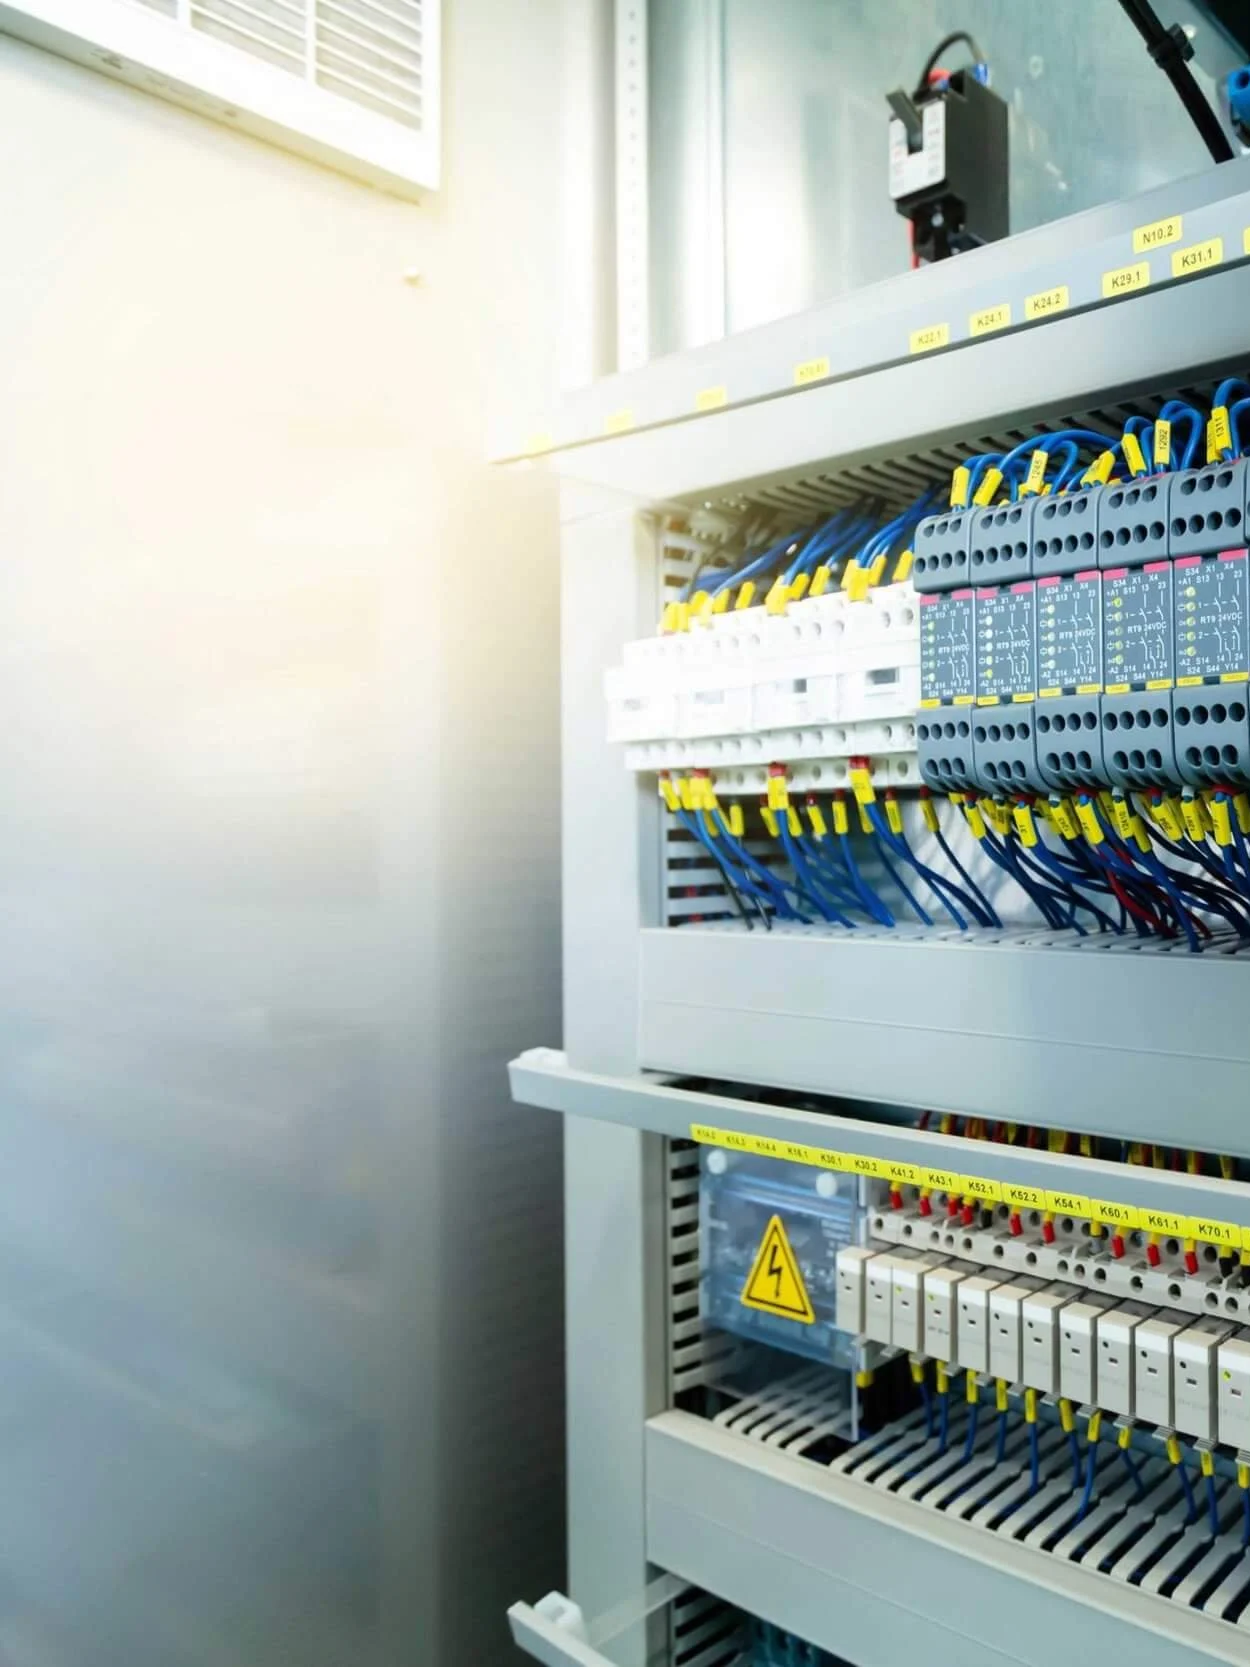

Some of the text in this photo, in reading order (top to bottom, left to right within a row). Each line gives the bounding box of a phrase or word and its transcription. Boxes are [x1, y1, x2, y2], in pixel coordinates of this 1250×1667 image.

[1142, 224, 1174, 245] N10.2
[1181, 247, 1213, 268] K31.1
[1111, 271, 1141, 290] K29.1
[1033, 292, 1061, 312] K24.2
[976, 311, 1003, 329] K24.1
[1185, 568, 1200, 577] S34
[1224, 562, 1235, 570] X4
[1216, 573, 1224, 581] 13
[1233, 570, 1243, 578] 23
[820, 1153, 843, 1167] K30.1
[854, 1159, 878, 1173] K30.2
[890, 1166, 915, 1180] K41.2
[928, 1174, 953, 1187] K43.1
[968, 1181, 994, 1195] K52.1
[1009, 1189, 1038, 1203] K52.2
[1053, 1196, 1082, 1211] K54.1
[1099, 1205, 1130, 1221] K60.1
[1147, 1214, 1179, 1231] K61.1
[1198, 1222, 1231, 1239] K70.1
